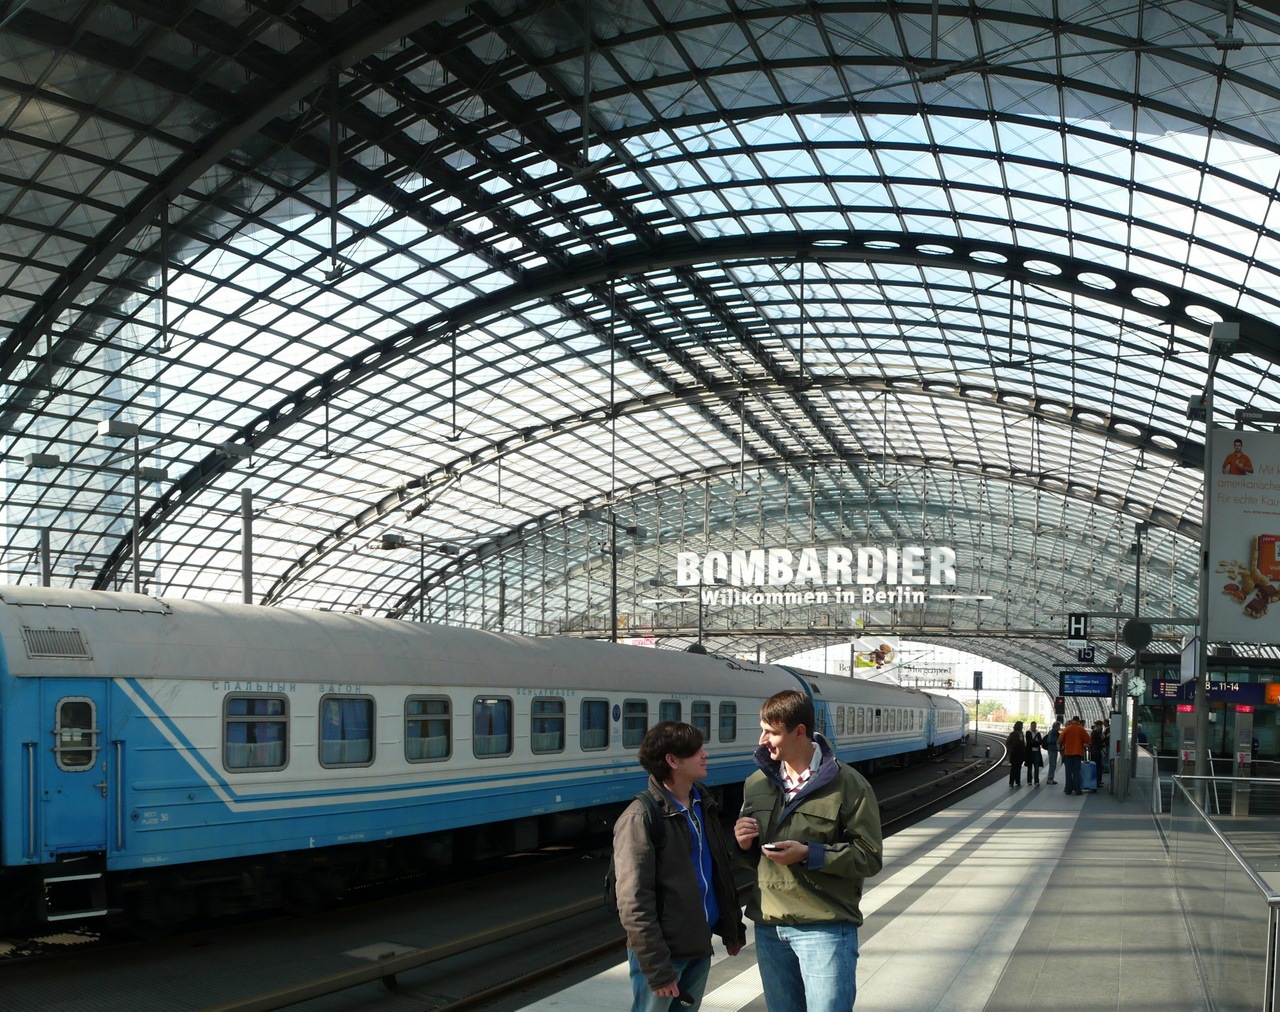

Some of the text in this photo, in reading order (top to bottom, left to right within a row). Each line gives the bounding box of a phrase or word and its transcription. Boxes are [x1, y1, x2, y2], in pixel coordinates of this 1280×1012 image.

[1258, 463, 1274, 475] Mit
[1217, 491, 1230, 504] Für
[1234, 493, 1258, 505] echte
[676, 547, 956, 587] BOMBARDIER
[700, 587, 925, 606] Willkommen in Berlin
[1070, 616, 1085, 636] H
[1081, 647, 1093, 659] 15
[839, 663, 851, 671] Ber
[907, 664, 952, 676] Morgenpost
[319, 684, 361, 694] ВАГОН
[1205, 681, 1211, 691] 8
[1219, 682, 1240, 691] 11-14
[516, 688, 576, 697] SCHLAFWAGEN
[160, 813, 168, 821] 30
